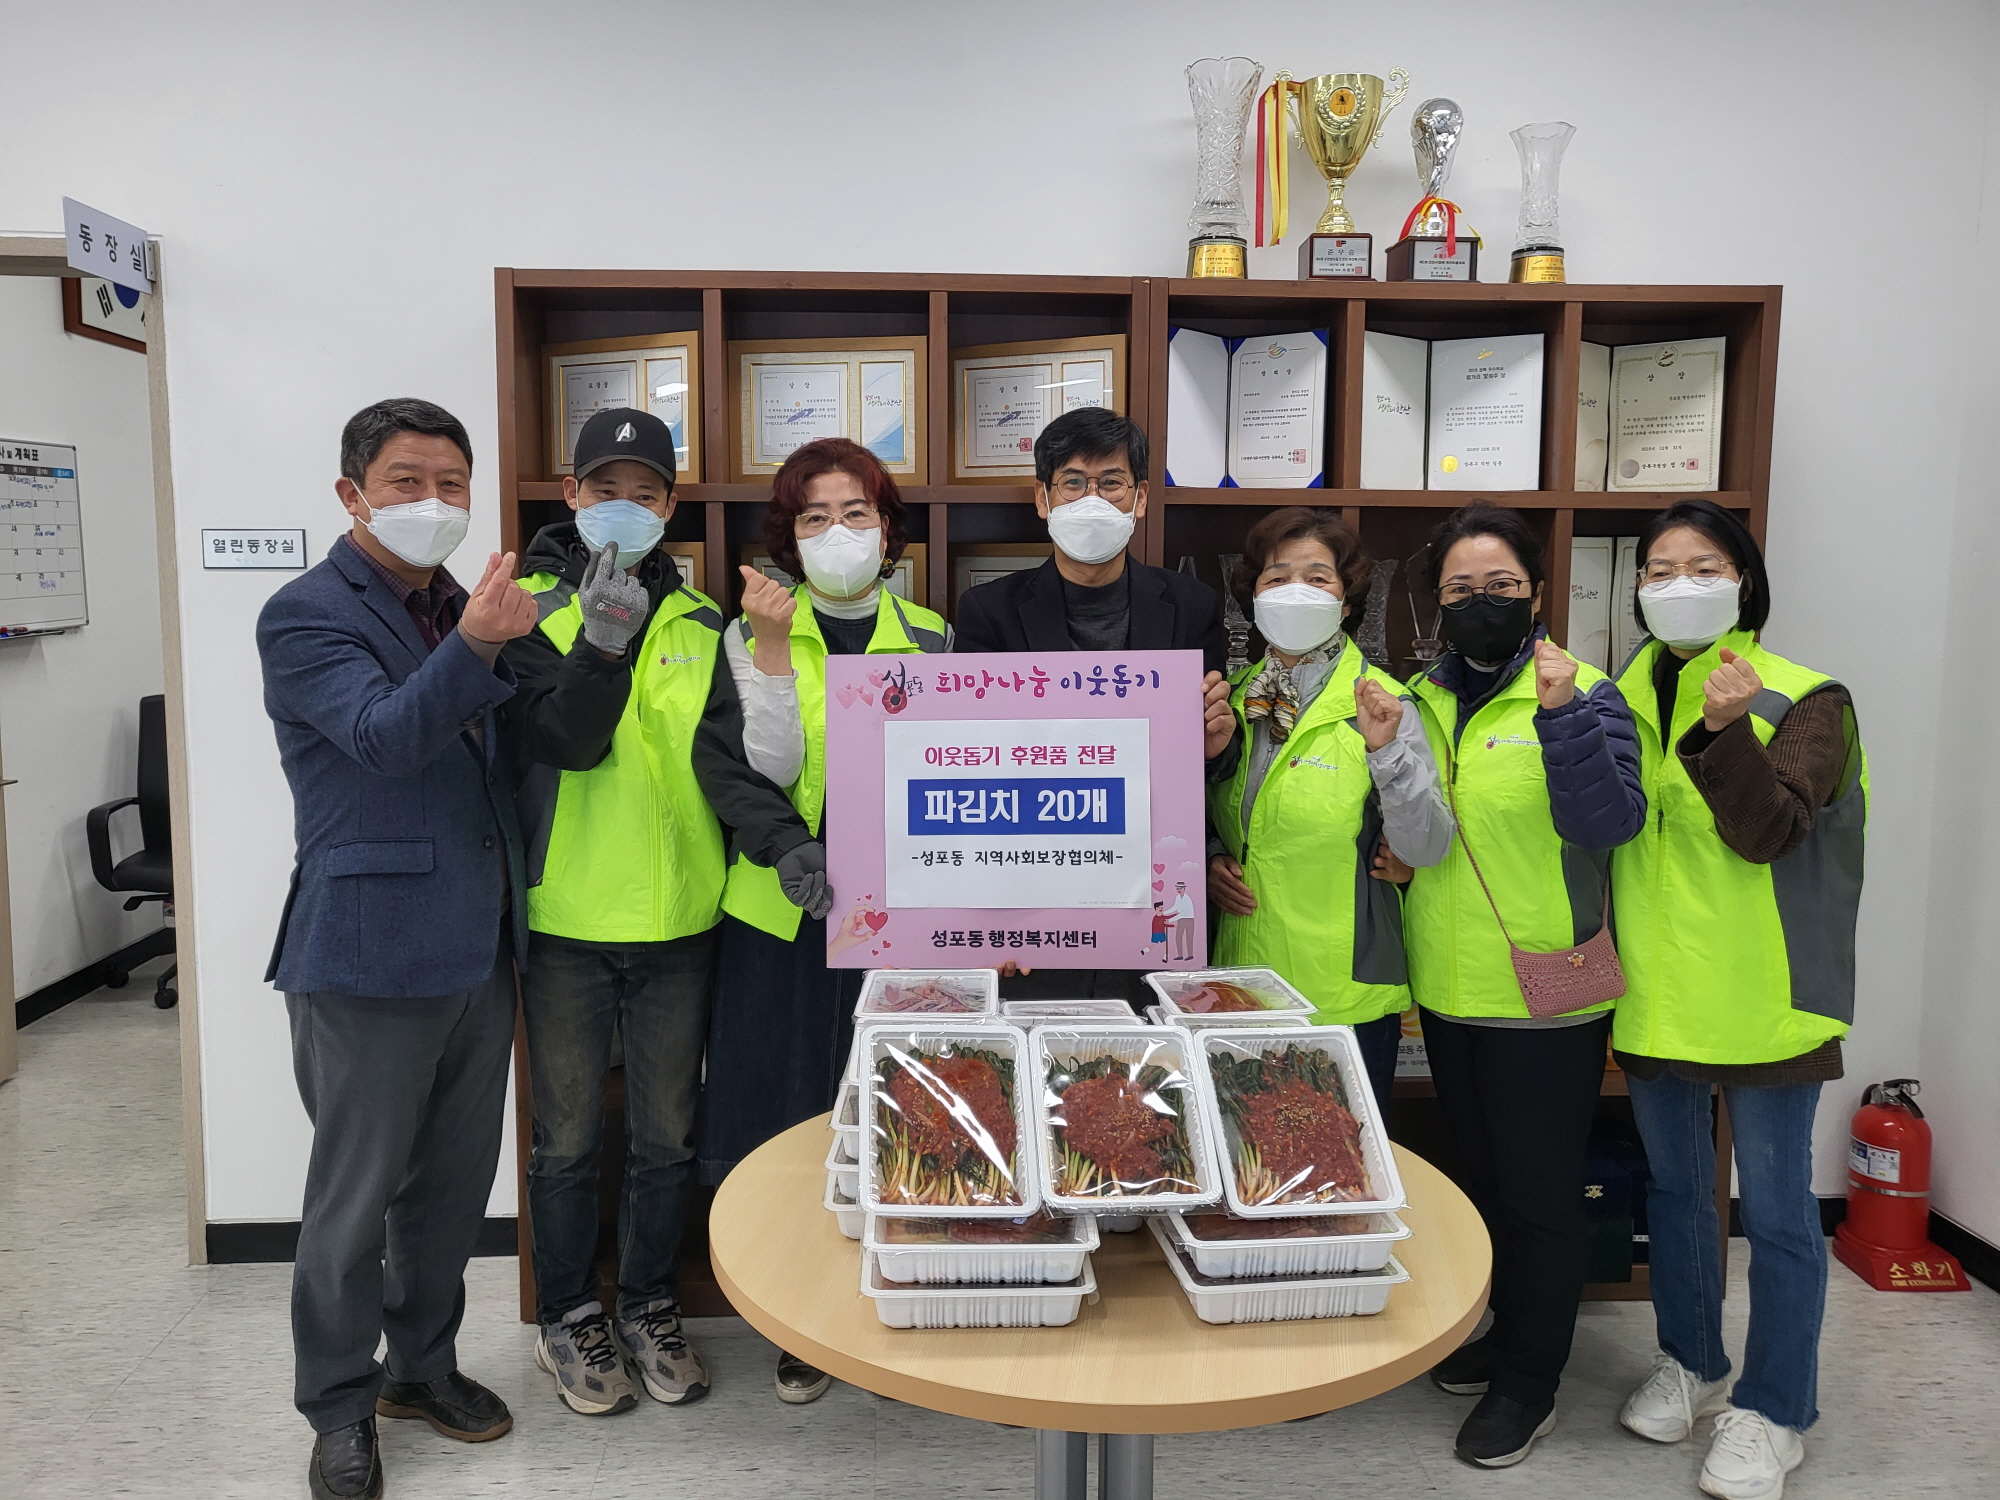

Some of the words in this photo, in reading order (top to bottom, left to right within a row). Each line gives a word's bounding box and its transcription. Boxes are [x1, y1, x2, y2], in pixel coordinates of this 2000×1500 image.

[14, 447, 39, 461] 계획표
[212, 537, 295, 555] 열린동장실
[936, 664, 1052, 699] 희망나눔
[1060, 664, 1160, 699] 이웃돕기
[924, 745, 1001, 767] 이웃돕기
[1010, 745, 1068, 766] 후원품
[1077, 744, 1117, 766] 전달
[924, 788, 1020, 824] 파김치
[1037, 788, 1108, 823] 20개
[1889, 1260, 1956, 1280] 소화기
